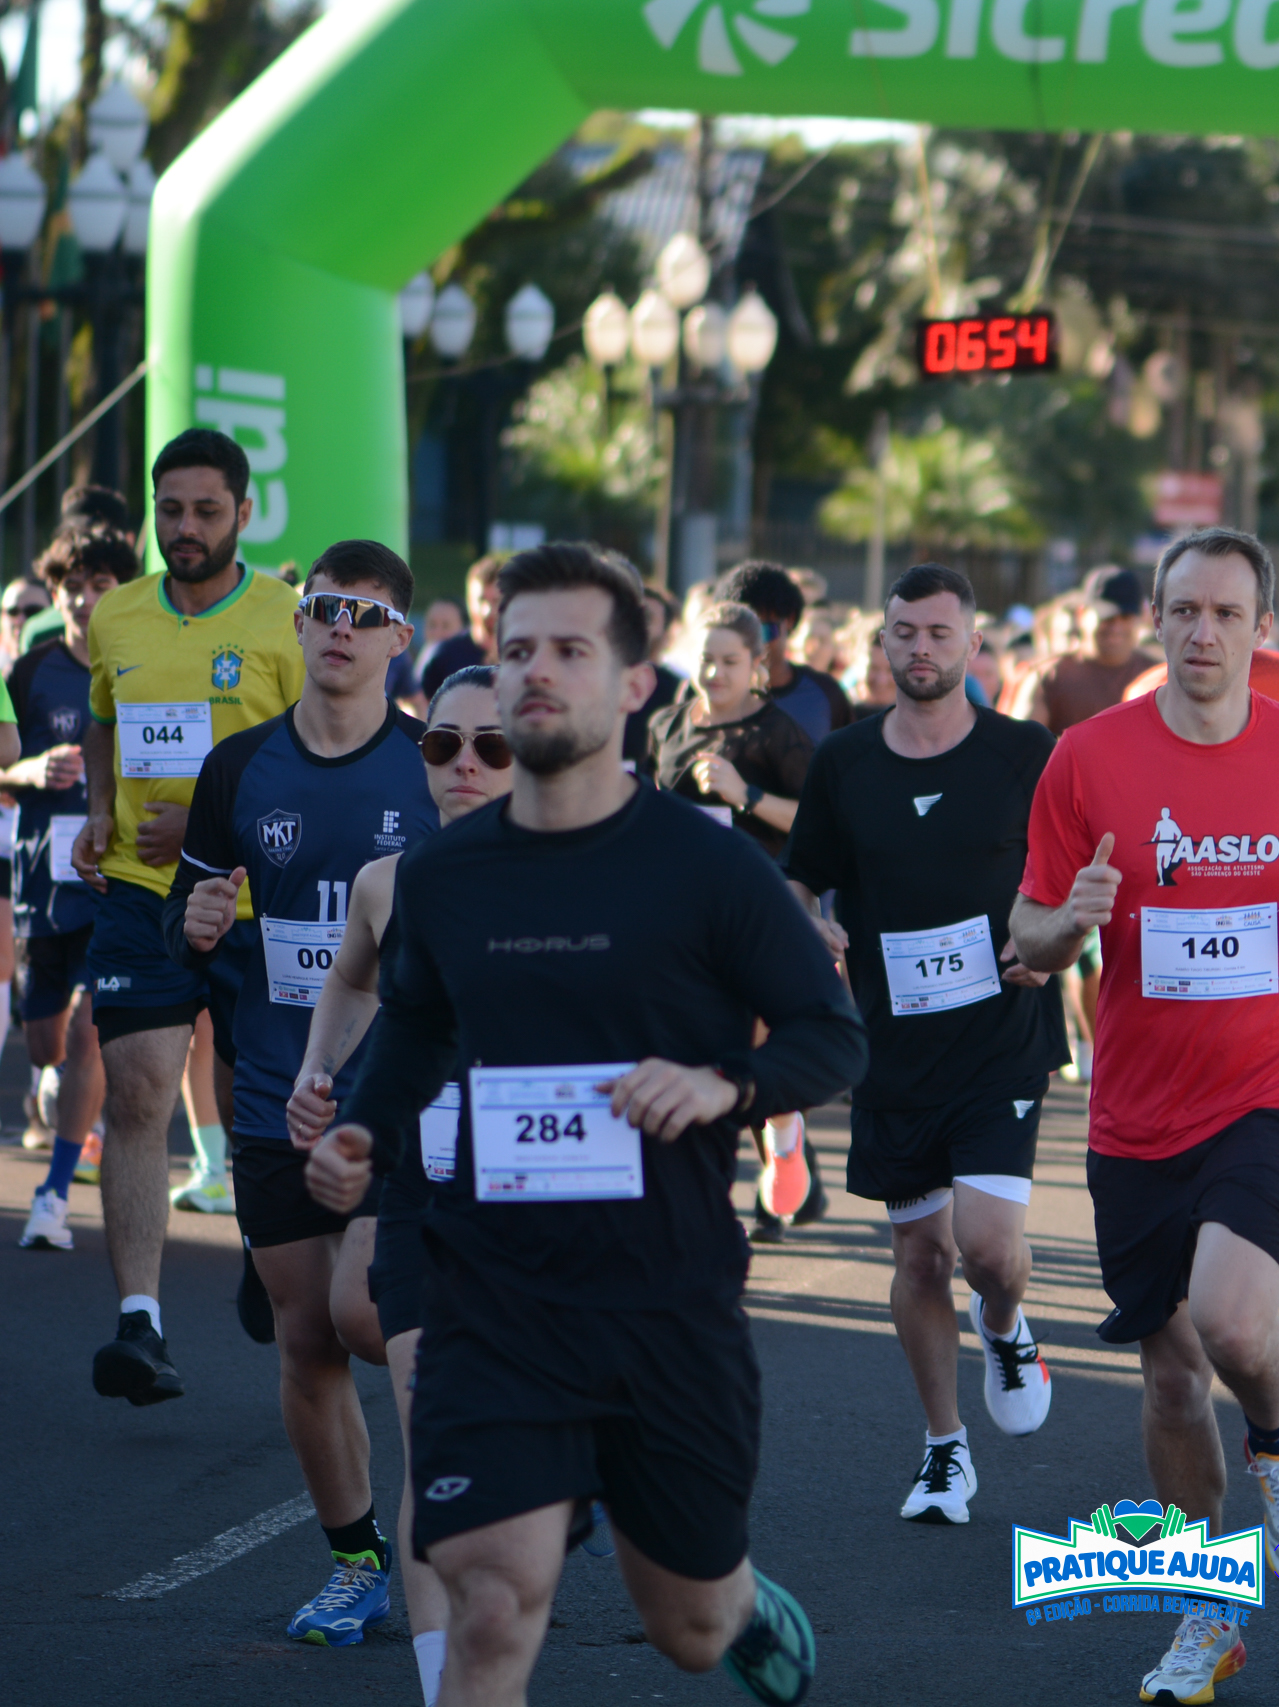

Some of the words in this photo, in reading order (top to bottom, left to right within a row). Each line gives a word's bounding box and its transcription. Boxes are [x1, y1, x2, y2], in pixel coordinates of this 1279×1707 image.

[925, 317, 1049, 373] 0654
[208, 696, 243, 705] BRASIL
[142, 725, 184, 744] 044
[262, 821, 296, 848] MKT
[374, 833, 406, 842] INSTITUTO
[1187, 864, 1222, 872] ASSOCIAÇÃO
[317, 880, 347, 922] 11
[488, 933, 611, 953] HORUS
[1182, 936, 1239, 959] 140
[297, 948, 339, 970] 00
[915, 952, 964, 978] 175
[515, 1112, 587, 1143] 284
